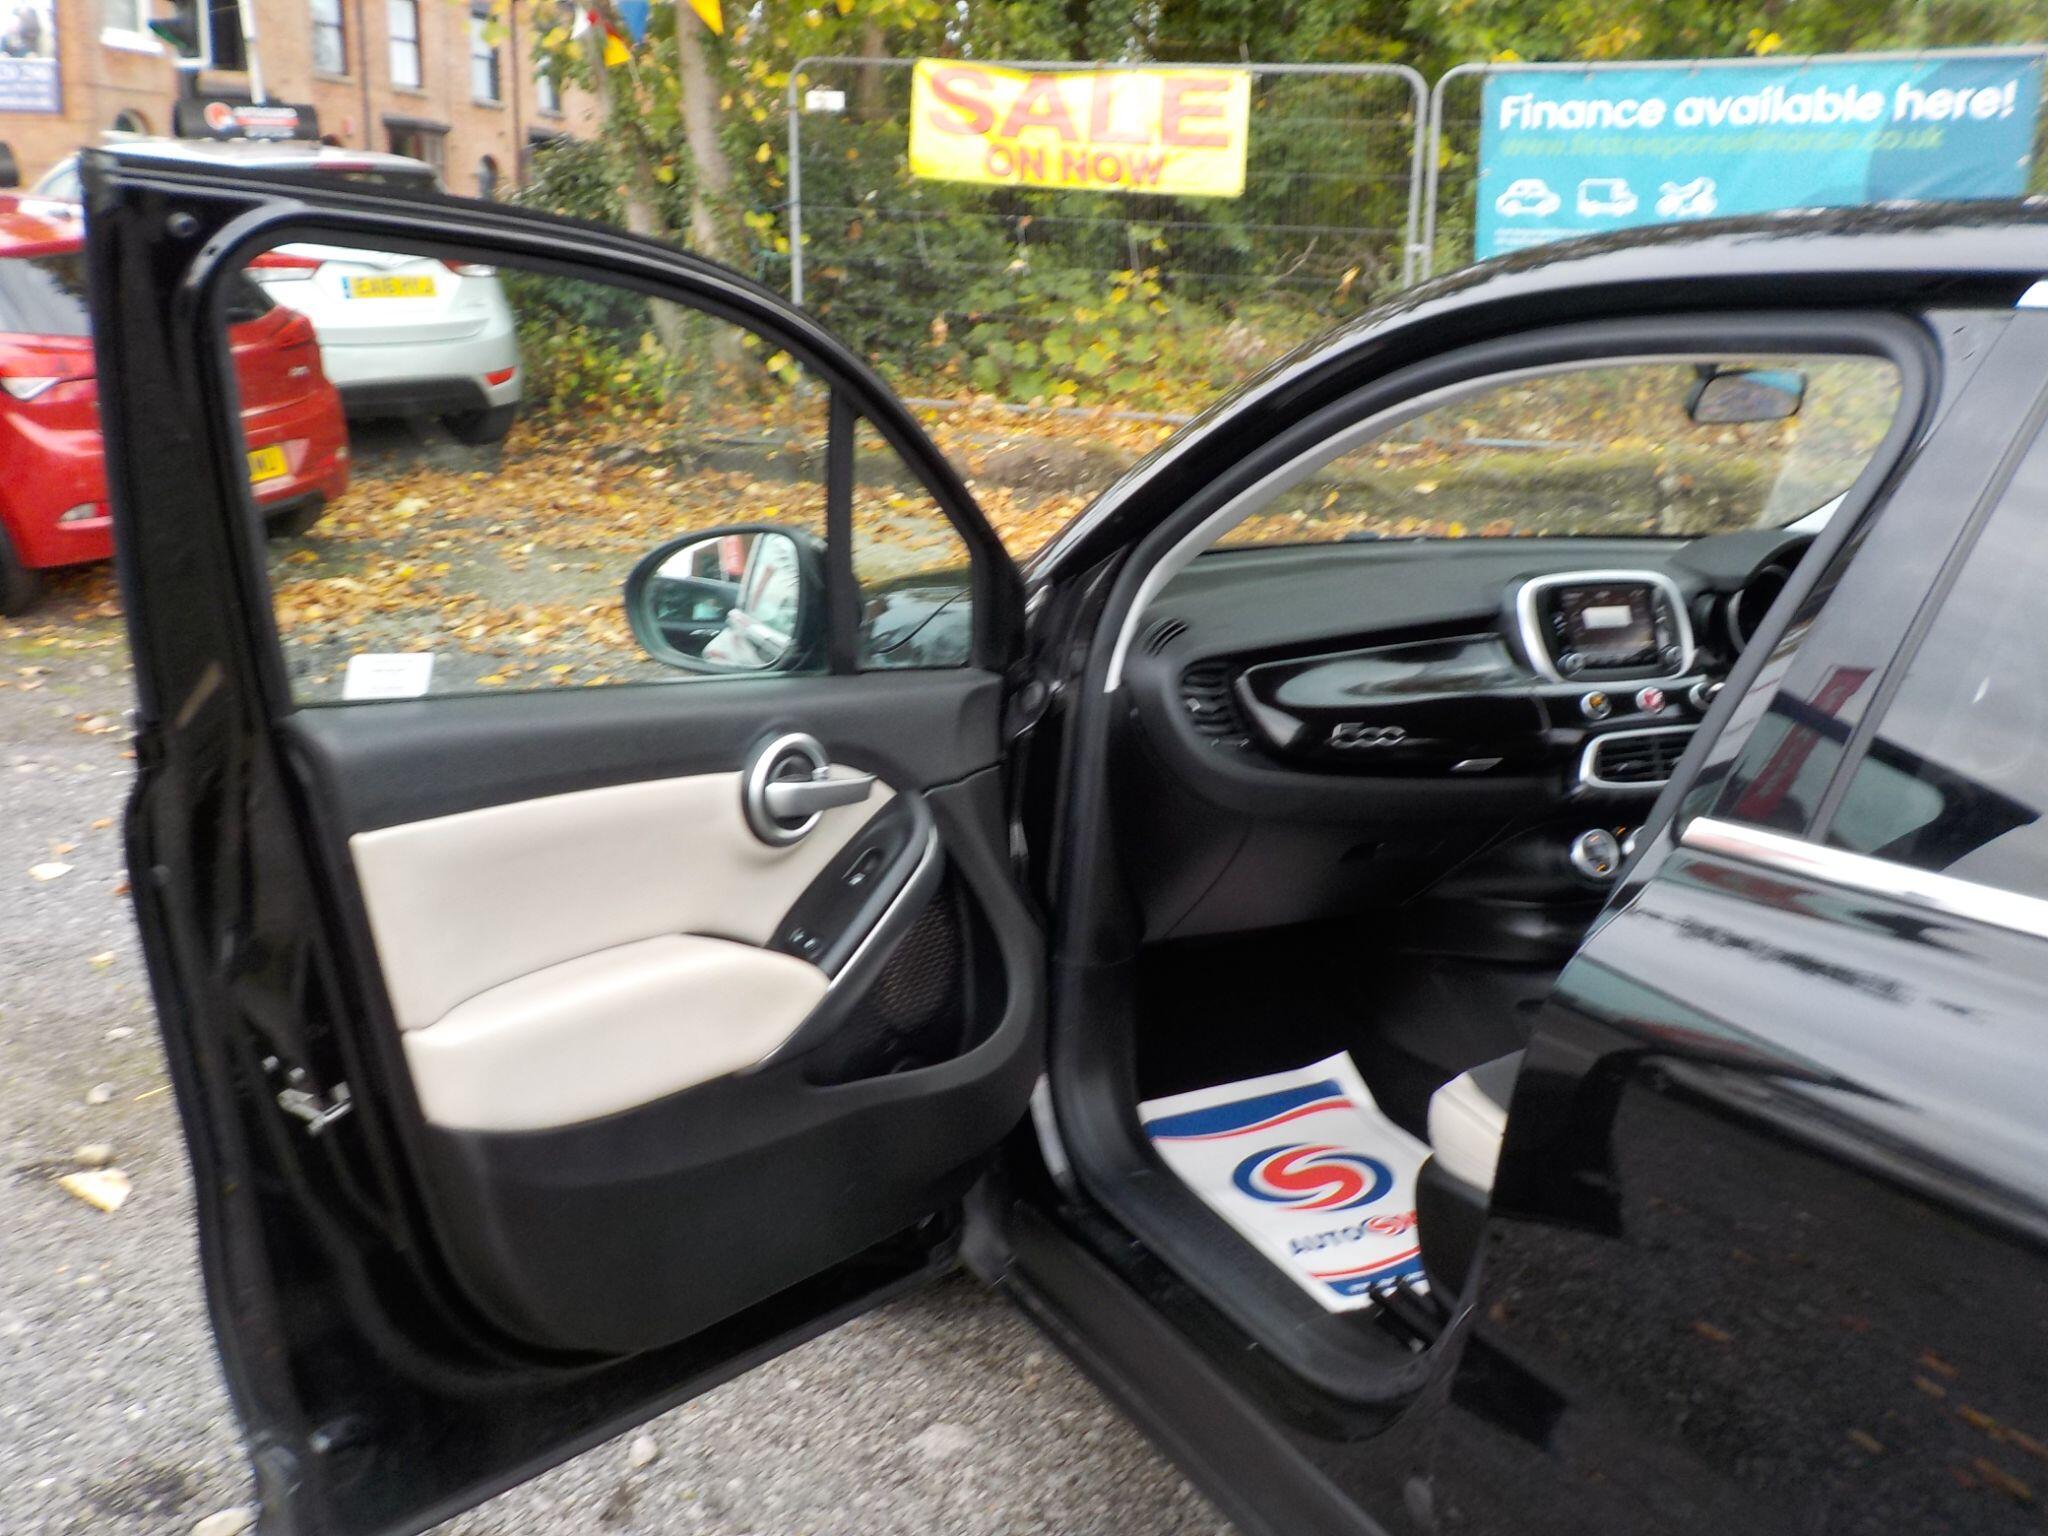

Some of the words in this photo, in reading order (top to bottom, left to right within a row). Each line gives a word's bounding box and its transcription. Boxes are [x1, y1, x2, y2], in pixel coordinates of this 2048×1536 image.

[929, 65, 1230, 147] SALE
[1499, 92, 1667, 130] Finance
[1674, 83, 1885, 126] available
[1893, 79, 2018, 121] here!
[986, 143, 1045, 182] ON
[1060, 150, 1166, 185] NOW
